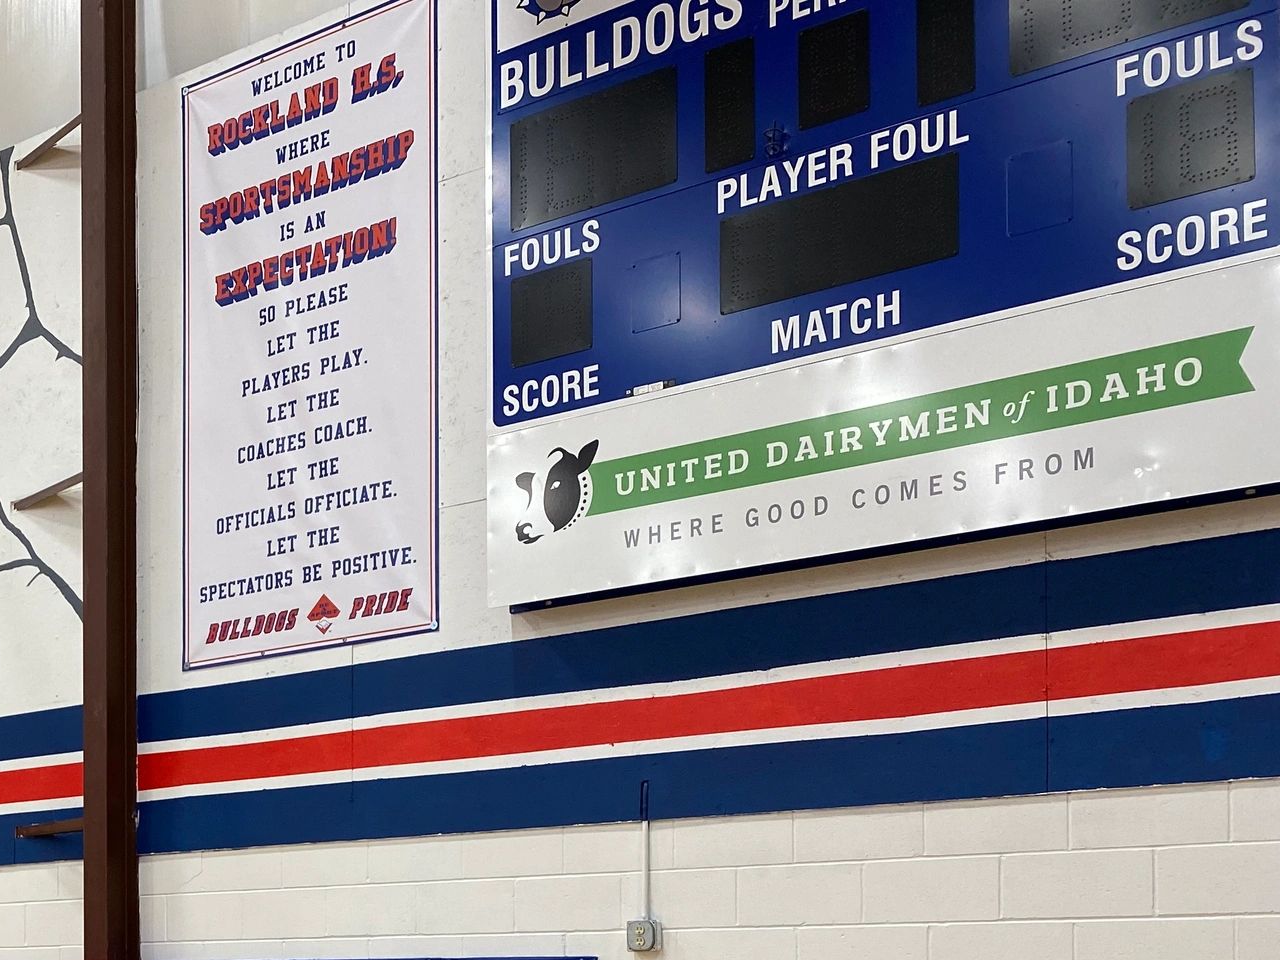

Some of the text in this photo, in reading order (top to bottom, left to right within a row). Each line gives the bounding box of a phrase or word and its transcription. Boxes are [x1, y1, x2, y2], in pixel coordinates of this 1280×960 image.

[251, 40, 356, 97] WELCOME TO
[500, 0, 743, 109] BULLDOGS
[1116, 19, 1263, 96] FOULS
[207, 53, 404, 156] ROCKLAND H.S.
[275, 129, 330, 164] WHERE
[717, 110, 969, 214] PLAYER FOUL
[199, 129, 414, 235] SPORTSMANSHIP
[280, 211, 326, 242] IS AN
[504, 219, 600, 277] FOULS
[1116, 199, 1268, 271] SCORE
[215, 217, 397, 307] EXPECTATION!
[259, 283, 348, 326] SO PLEASE
[771, 290, 901, 354] MATCH
[267, 320, 340, 357] LET THE
[241, 348, 367, 397] PLAYERS PLAY.
[503, 364, 600, 417] SCORE
[266, 388, 340, 423] LET THE
[615, 357, 1203, 496] UNITED DAIRYMEN of IDAHO
[237, 416, 372, 464] COACHES COACH.
[267, 457, 339, 491] LET THE
[624, 447, 1095, 548] WHERE GOOD COMES FROM
[216, 480, 397, 535] OFFICIALS OFFICIATE.
[266, 526, 340, 557] LET THE
[200, 546, 417, 603] SPECTATORS BE POSITIVE.
[206, 608, 299, 644] BULLDOGS
[348, 588, 413, 620] PRIDE
